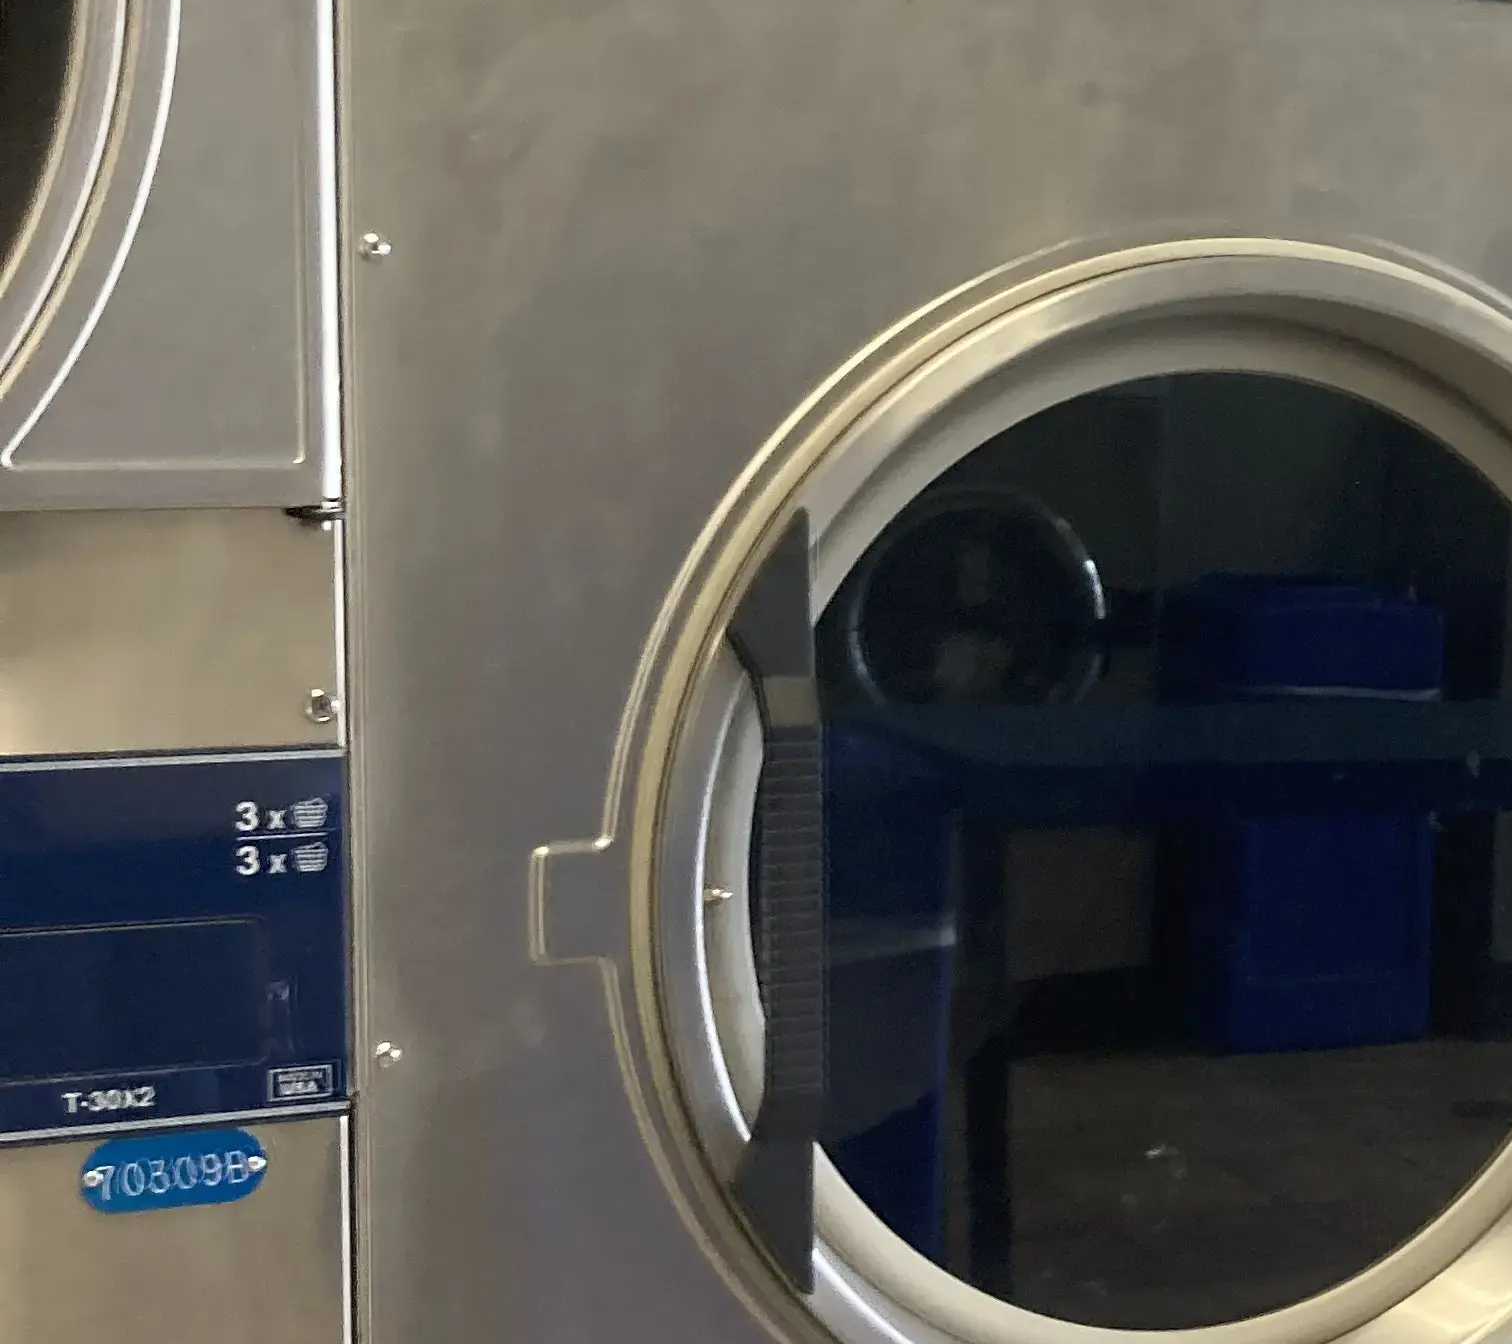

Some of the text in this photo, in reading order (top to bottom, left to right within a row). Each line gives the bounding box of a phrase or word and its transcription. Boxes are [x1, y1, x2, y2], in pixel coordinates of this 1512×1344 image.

[236, 801, 259, 831] 3
[236, 846, 260, 876] 3
[95, 1150, 250, 1201] 70309B
